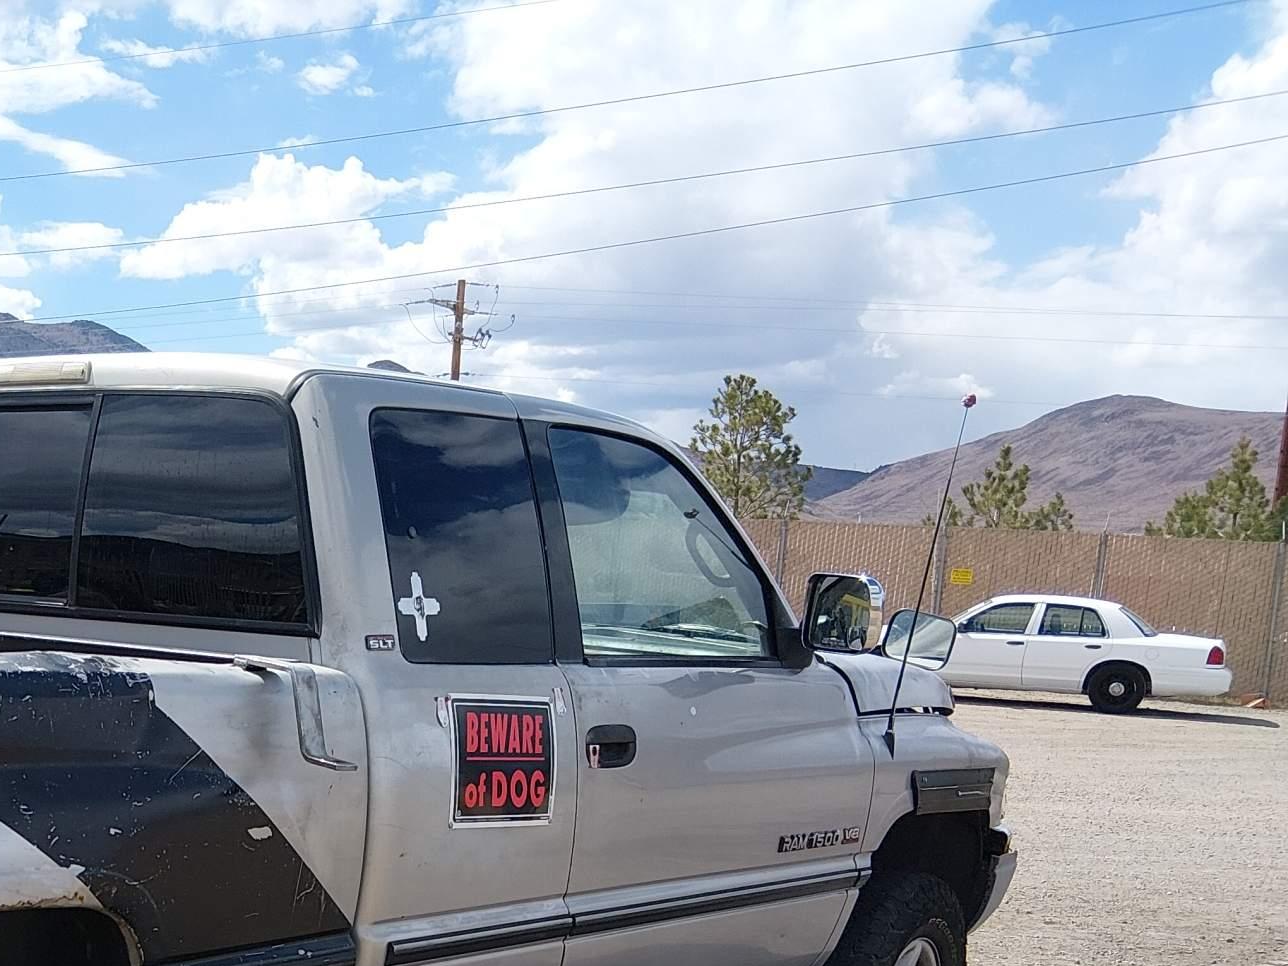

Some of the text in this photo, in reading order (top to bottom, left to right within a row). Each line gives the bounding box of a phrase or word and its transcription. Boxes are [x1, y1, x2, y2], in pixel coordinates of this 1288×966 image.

[369, 639, 394, 649] SLT
[466, 711, 543, 754] BEWARE
[464, 769, 546, 808] of DOG
[779, 827, 860, 852] RAM 1500 V8
